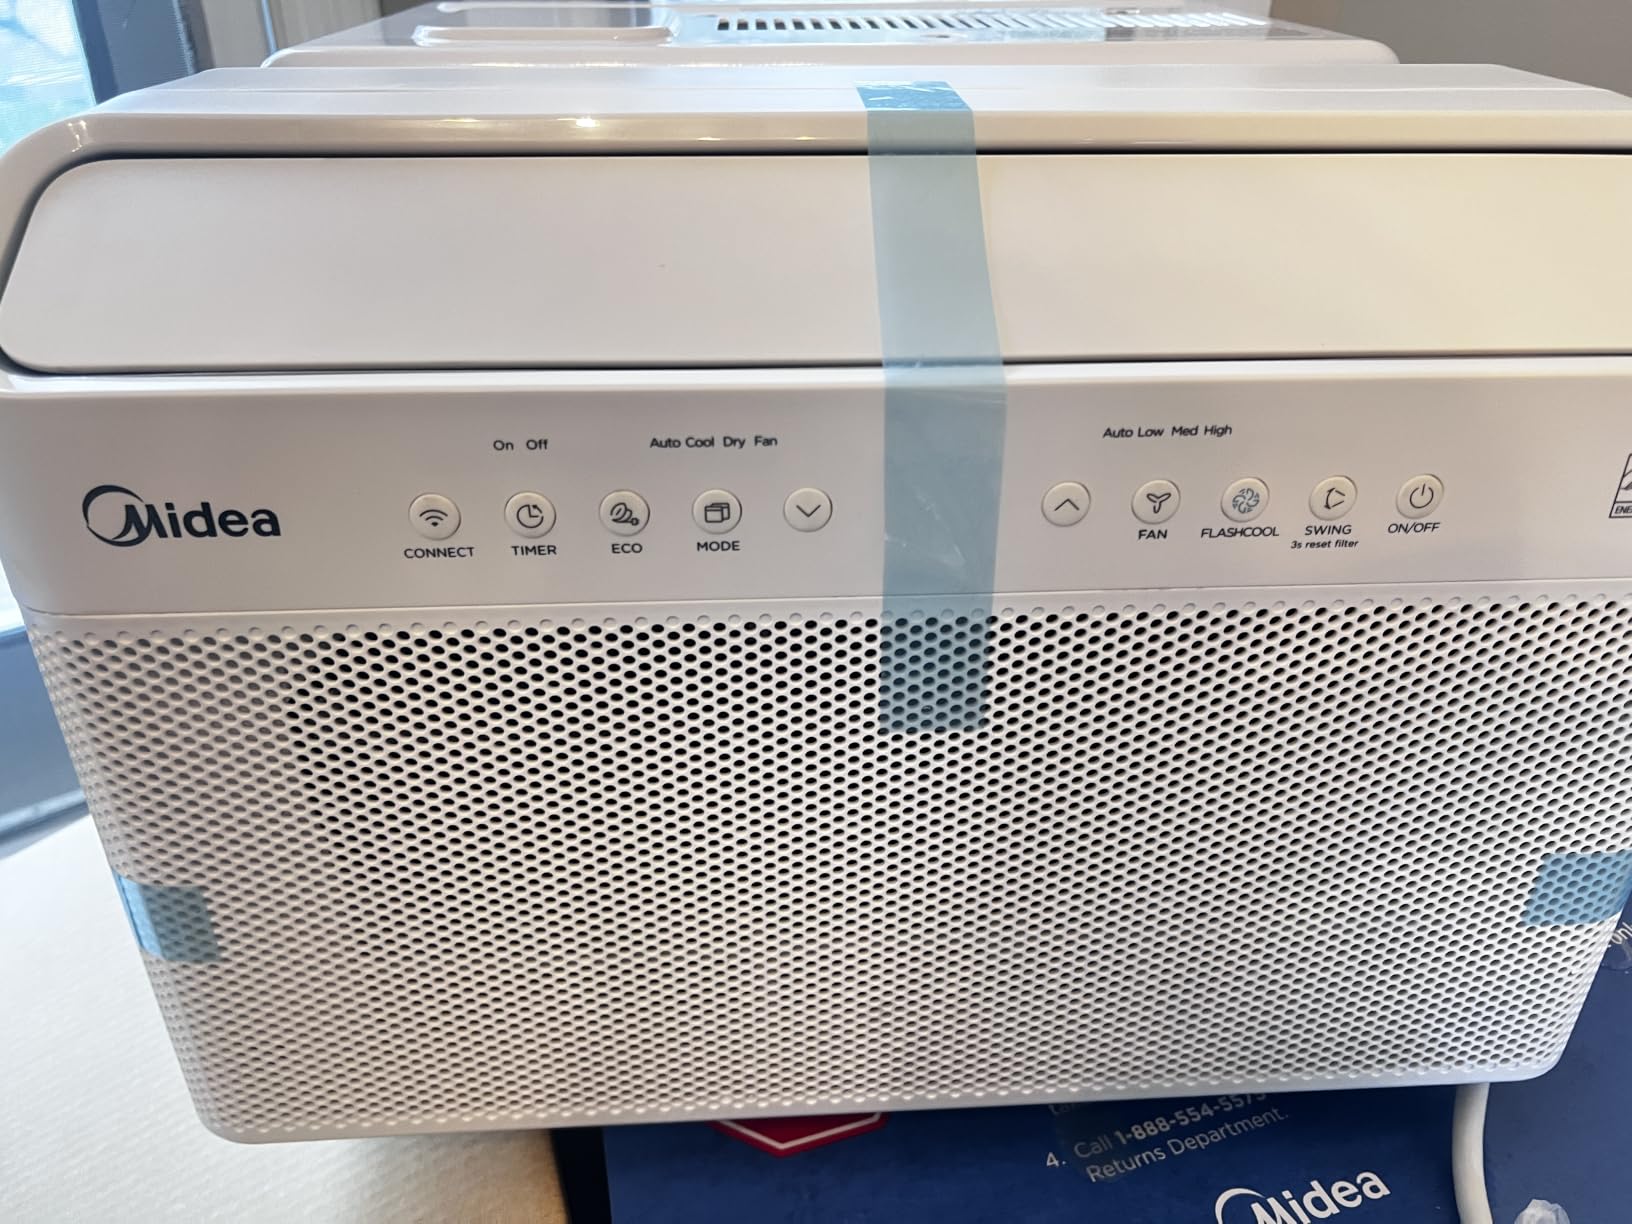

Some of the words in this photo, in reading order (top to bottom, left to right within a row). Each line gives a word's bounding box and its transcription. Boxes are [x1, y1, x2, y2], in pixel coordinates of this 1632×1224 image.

[1102, 426, 1134, 439] Auto
[1137, 425, 1165, 438] Low
[1170, 424, 1200, 437] Med
[1203, 424, 1233, 438] High
[493, 439, 515, 451] On
[525, 438, 549, 451] Off
[649, 436, 682, 449] Auto
[684, 435, 715, 449] Cool
[722, 435, 747, 450] Dry
[753, 434, 779, 447] Fan
[82, 484, 282, 547] Midea
[1137, 528, 1168, 540] FAN
[1200, 525, 1279, 538] FLASHCOOL
[1304, 523, 1353, 536] SWING
[1387, 520, 1441, 535] ON/OFF
[510, 543, 558, 556] TIMER
[610, 542, 644, 555] ECO
[696, 539, 741, 552] MODE
[1290, 539, 1303, 550] 3s
[1305, 539, 1332, 549] reset
[1334, 537, 1360, 549] filter
[403, 546, 475, 559] CONNECT
[1046, 1152, 1067, 1168] 4.
[1074, 1134, 1113, 1158] Call
[1086, 1147, 1166, 1183] Returns
[1167, 1106, 1289, 1155] Department.
[1215, 1171, 1391, 1224] Midea
